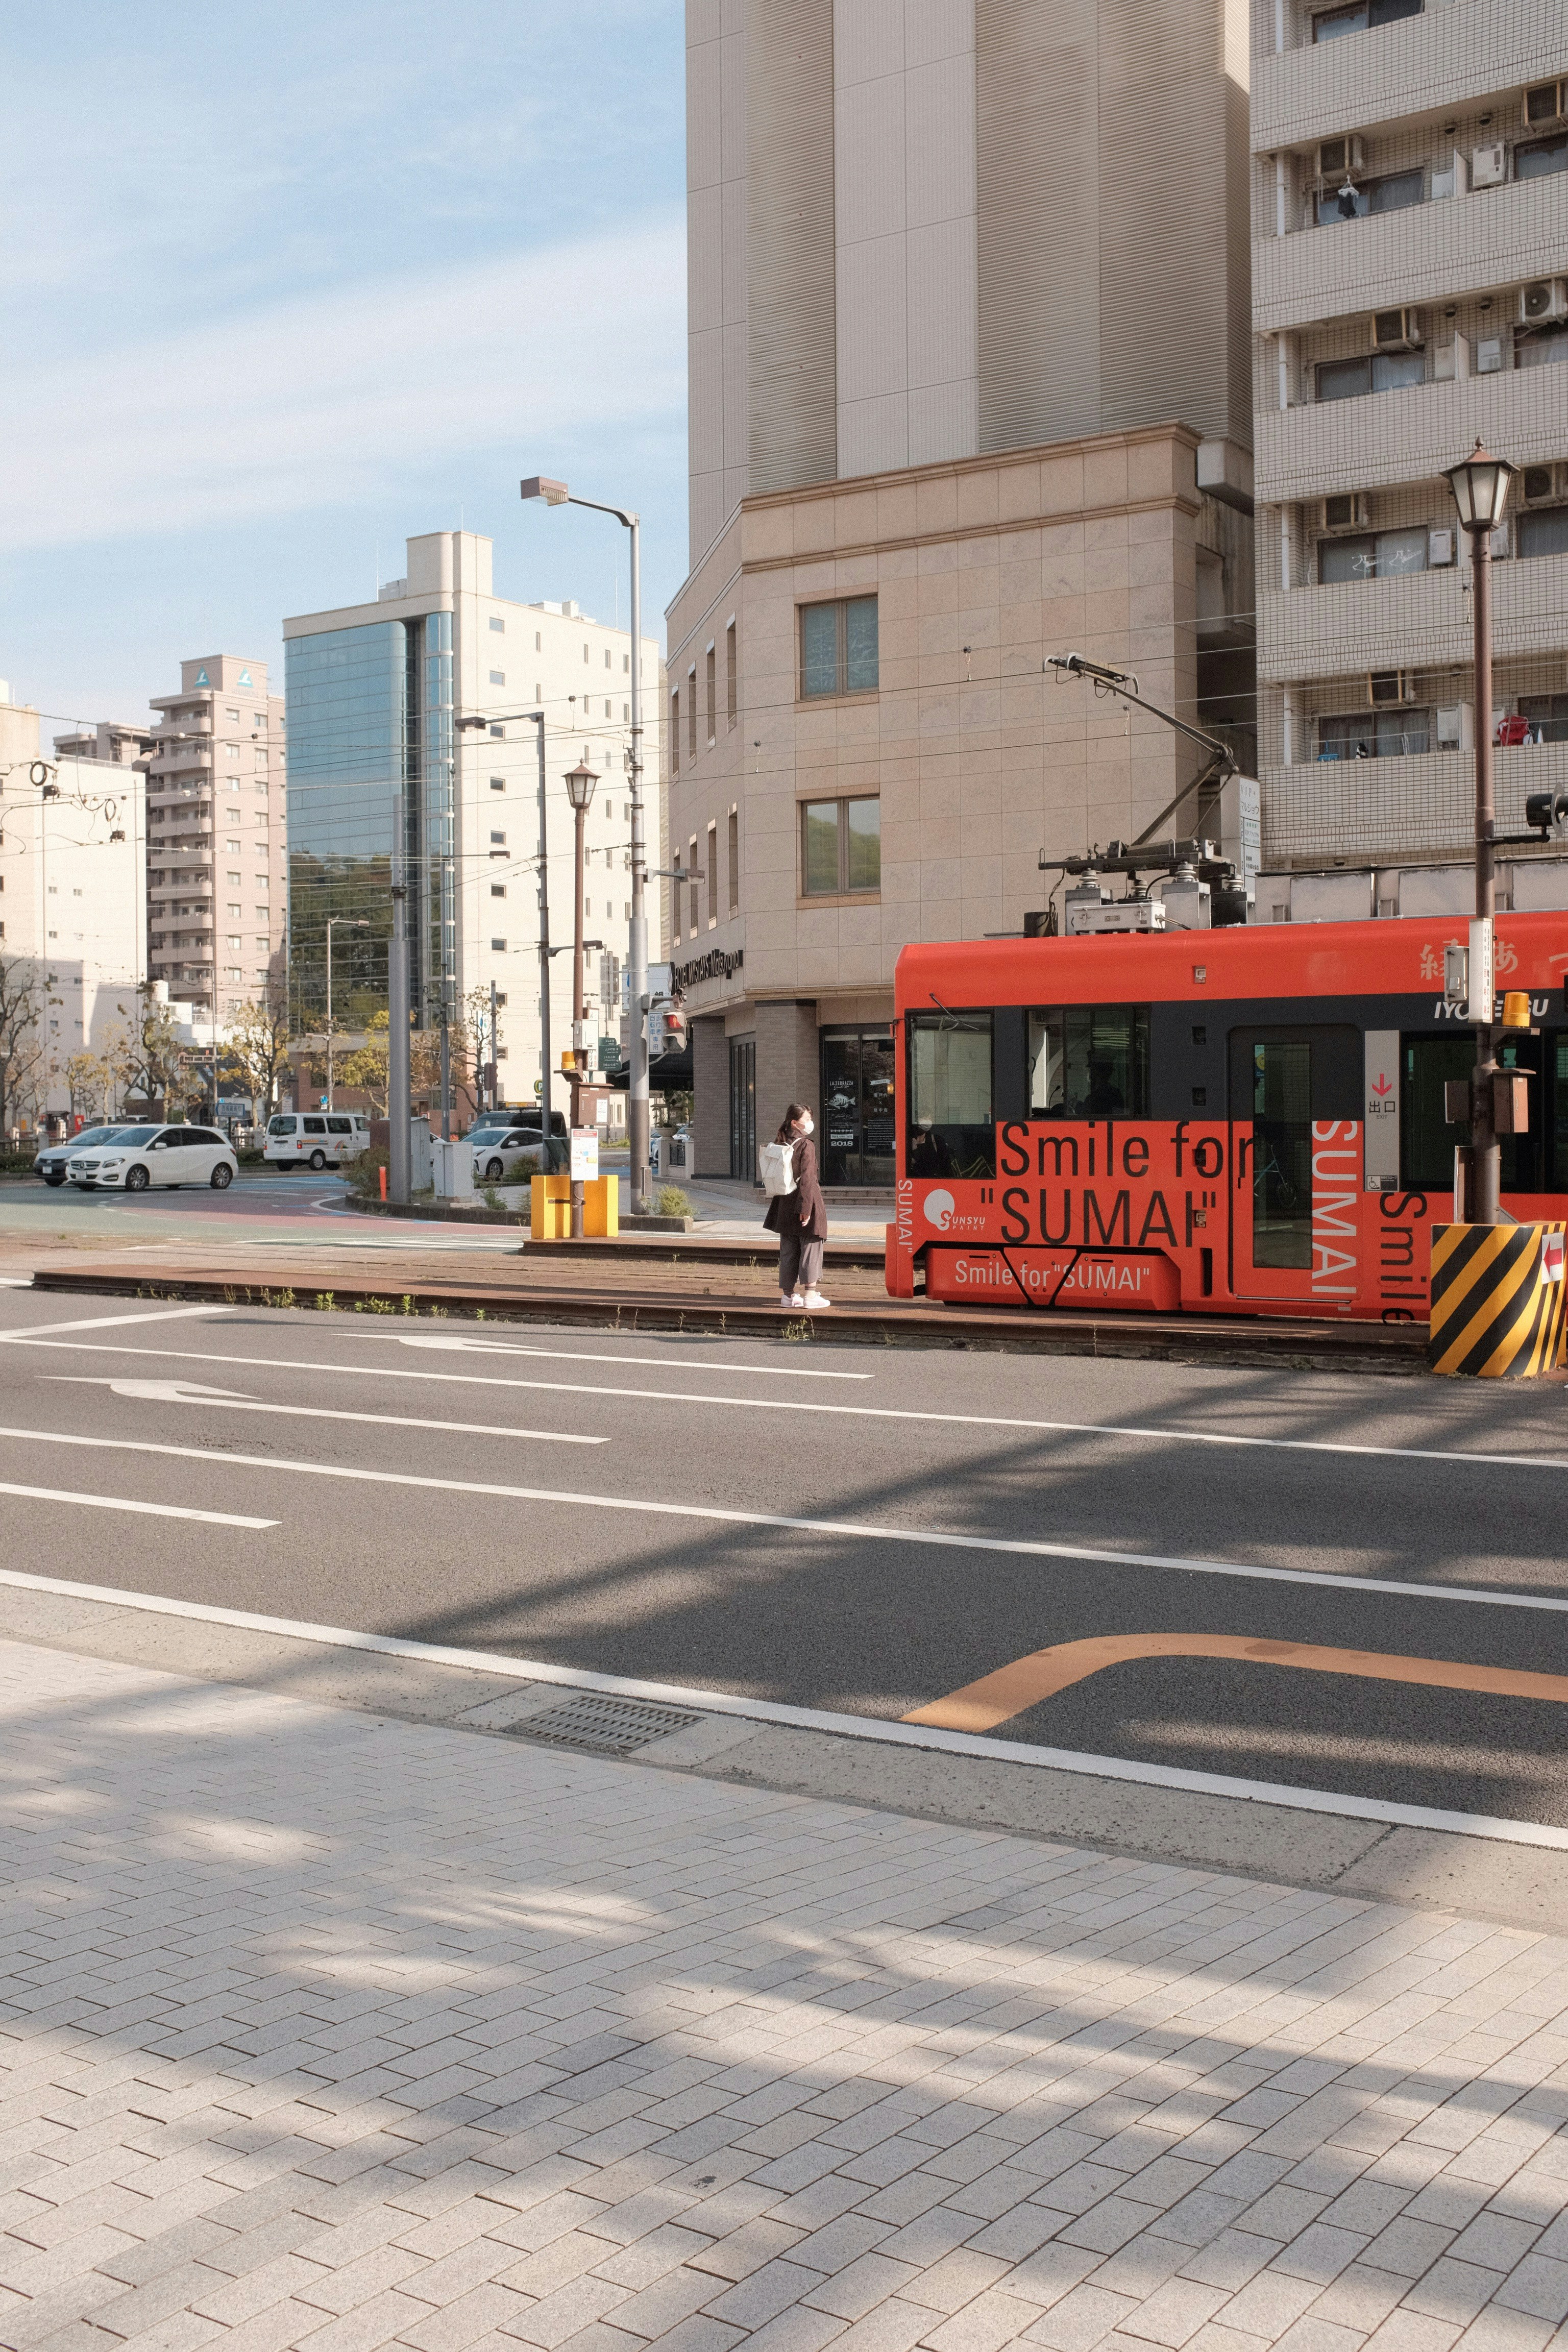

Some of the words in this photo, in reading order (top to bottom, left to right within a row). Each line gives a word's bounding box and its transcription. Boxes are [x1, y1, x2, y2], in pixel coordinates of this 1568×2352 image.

[1241, 801, 1259, 815] マルショウ
[674, 964, 689, 990] HOTEL
[689, 953, 710, 986] MYSTAYS
[653, 1036, 658, 1050] 専用
[1369, 1100, 1395, 1113] 出口
[1001, 1121, 1149, 1177] Smile
[1170, 1121, 1253, 1178] for
[898, 1179, 913, 1253] SUMAI"
[981, 1187, 1216, 1247] "SUMAI"
[955, 1260, 1013, 1285] Smile
[1021, 1264, 1050, 1287] for
[1054, 1264, 1150, 1290] "SUMAI"
[1380, 1192, 1428, 1325] Smile
